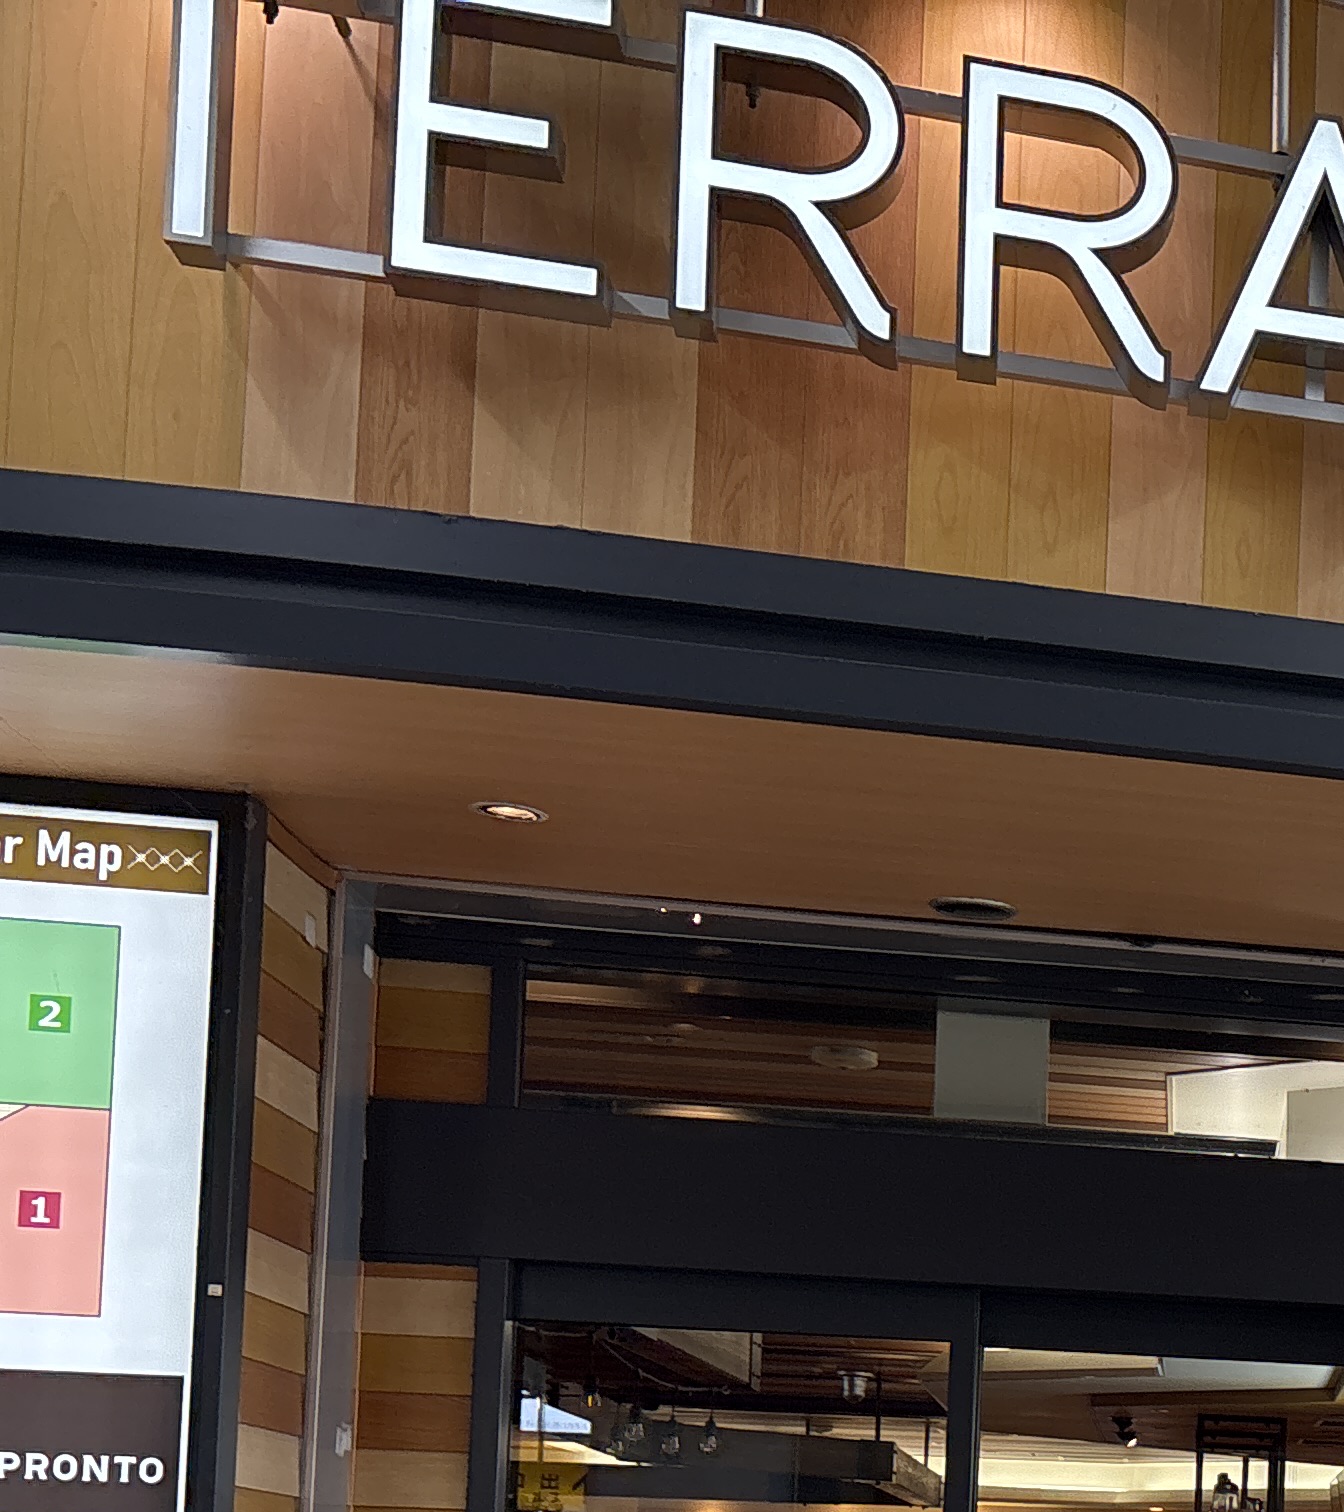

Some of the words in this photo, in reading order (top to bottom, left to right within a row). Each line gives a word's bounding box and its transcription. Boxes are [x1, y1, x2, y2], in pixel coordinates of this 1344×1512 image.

[0, 834, 24, 864] r
[36, 828, 123, 881] Map
[37, 999, 62, 1028] 2
[29, 1196, 50, 1223] 1
[0, 1451, 165, 1484] PRONTO
